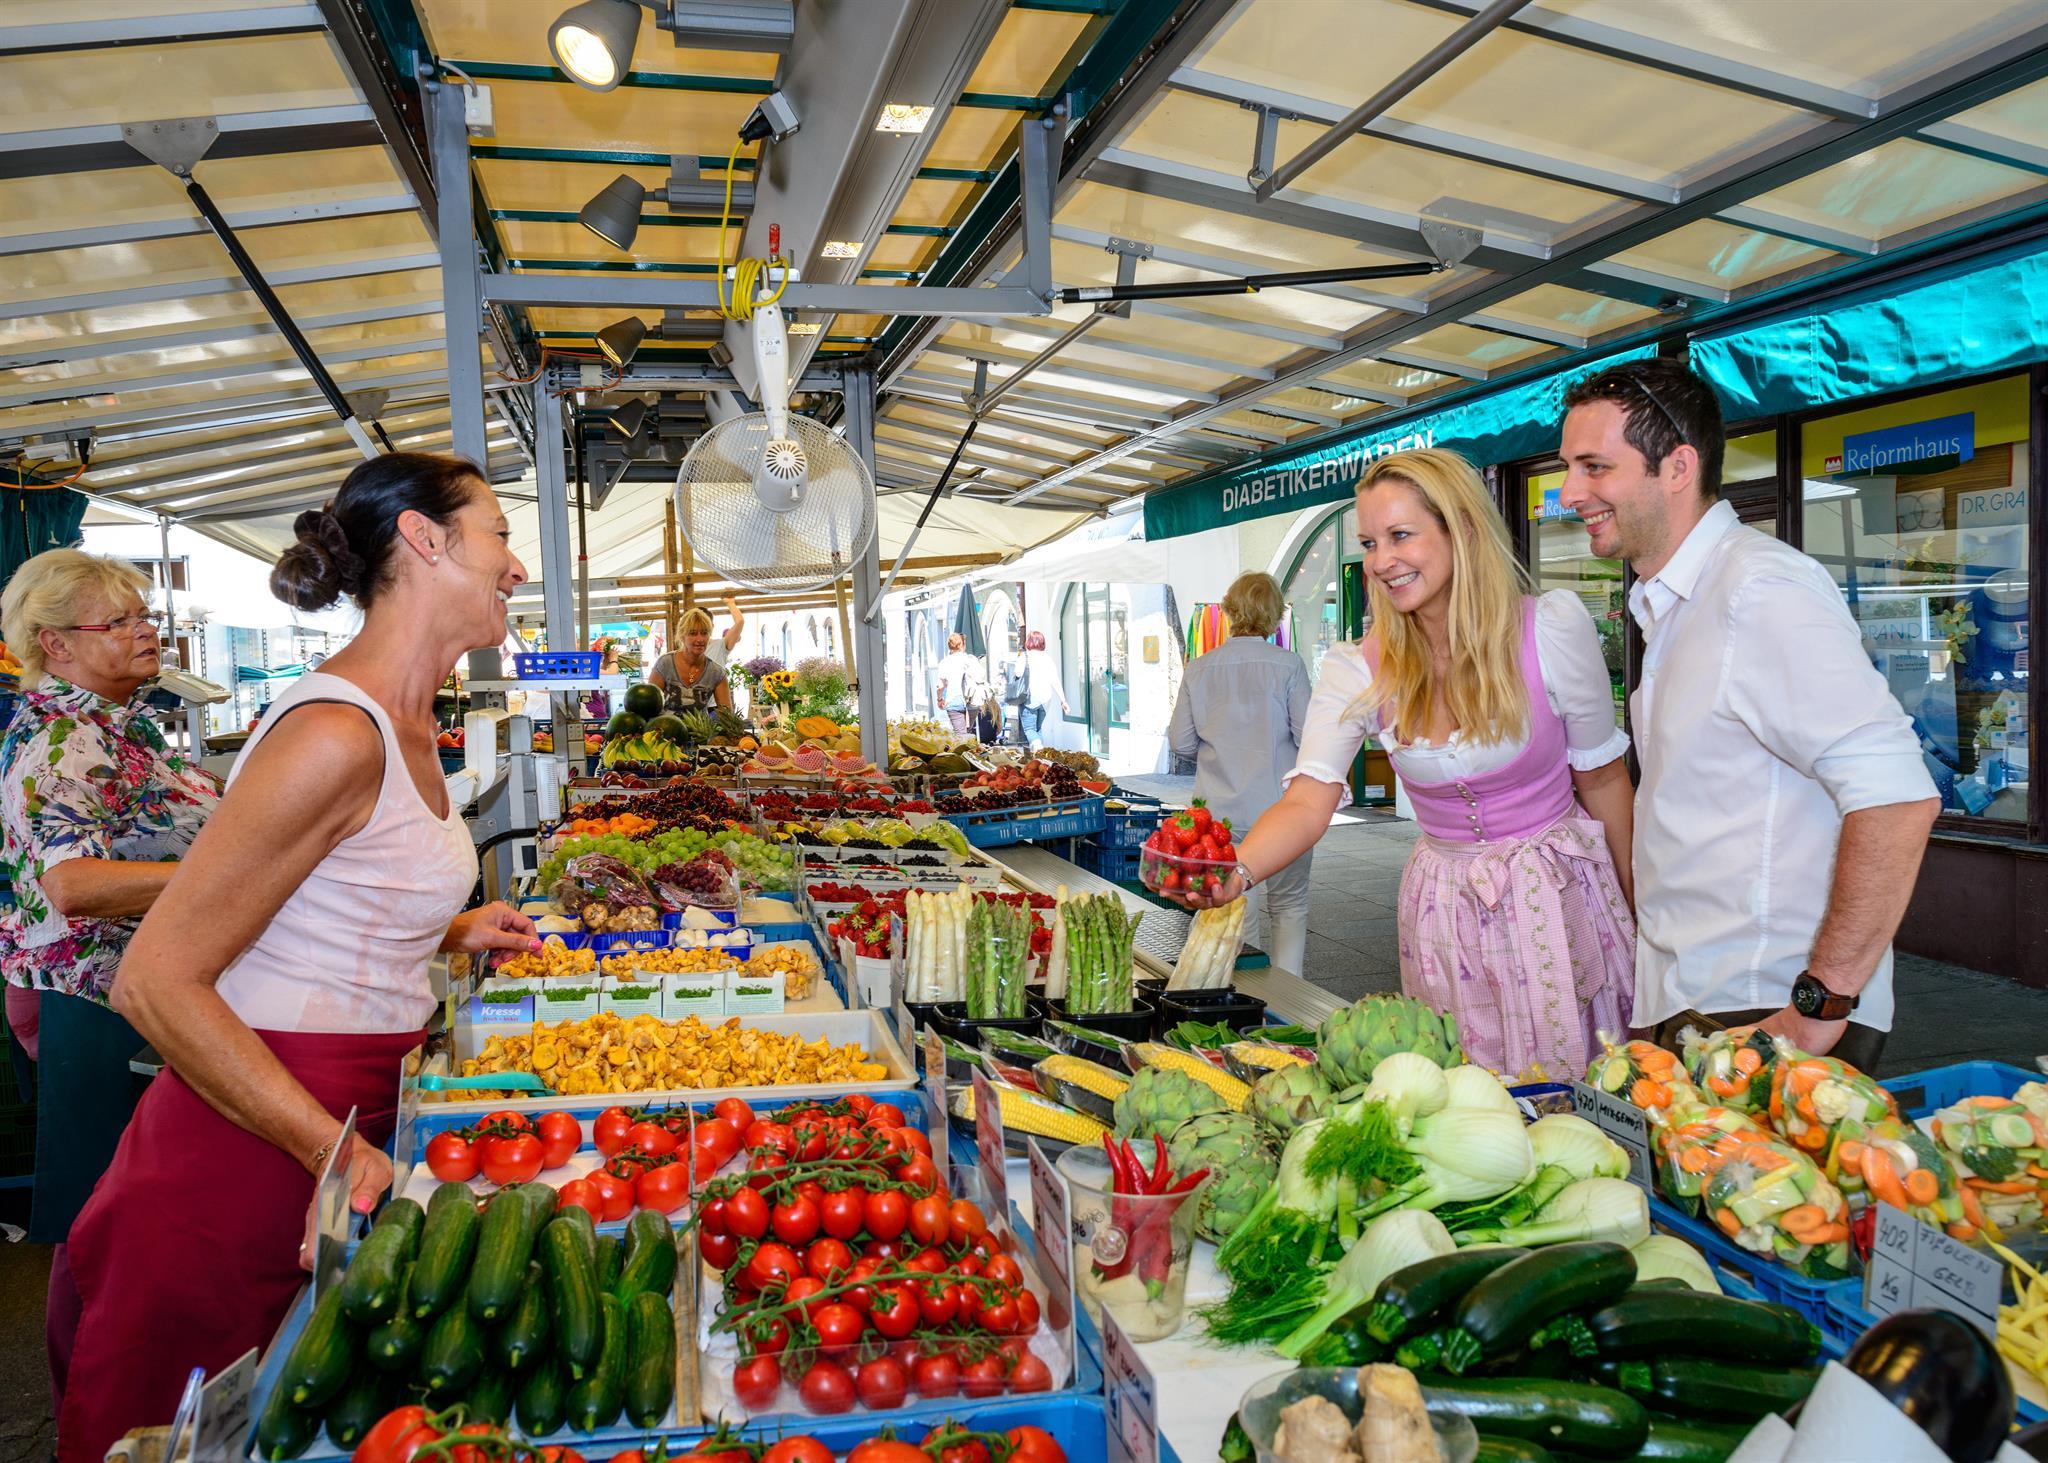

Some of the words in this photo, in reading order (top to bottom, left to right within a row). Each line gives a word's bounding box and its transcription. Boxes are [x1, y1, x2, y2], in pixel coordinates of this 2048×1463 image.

[1847, 437, 1961, 476] Reformhaus
[482, 1006, 521, 1016] Kresse
[1577, 1090, 1594, 1111] 470
